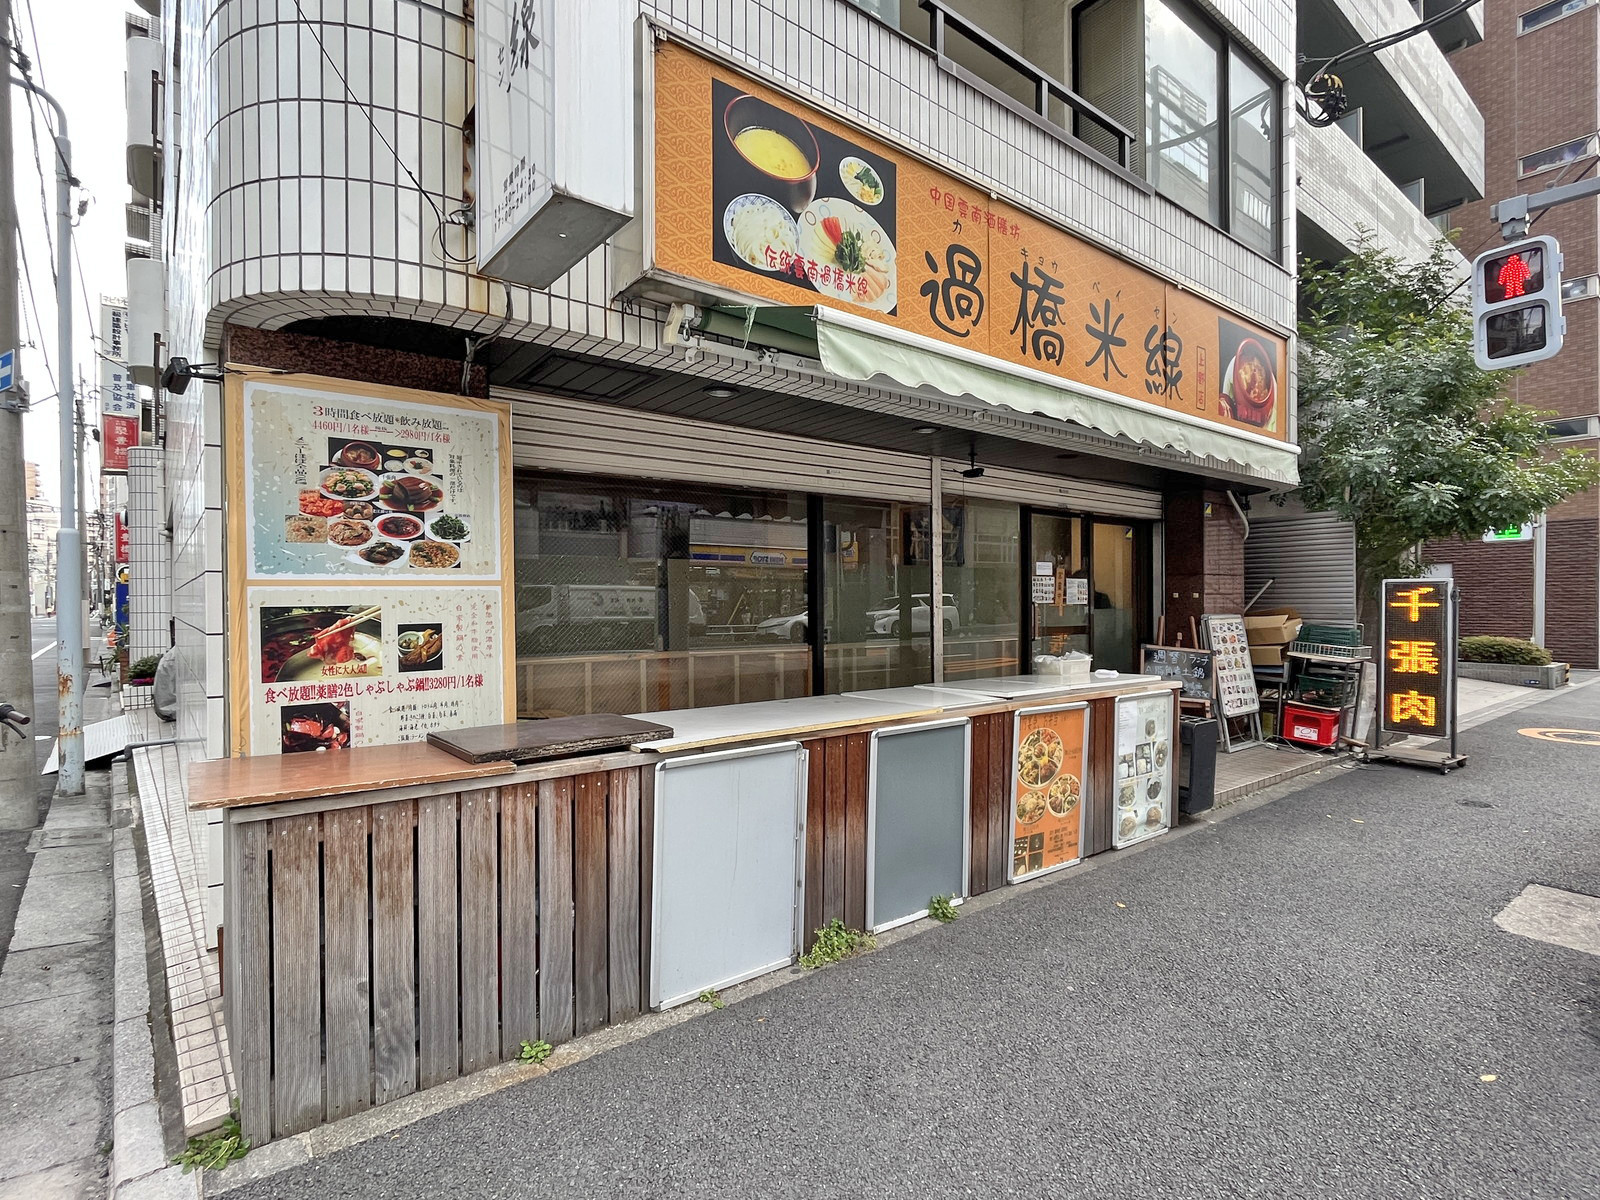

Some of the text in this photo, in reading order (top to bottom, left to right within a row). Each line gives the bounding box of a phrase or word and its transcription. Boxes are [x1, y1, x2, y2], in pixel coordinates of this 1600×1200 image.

[503, 156, 526, 193] 営業時間
[919, 243, 1184, 401] 過橋米線
[1389, 586, 1440, 727] 千張肉
